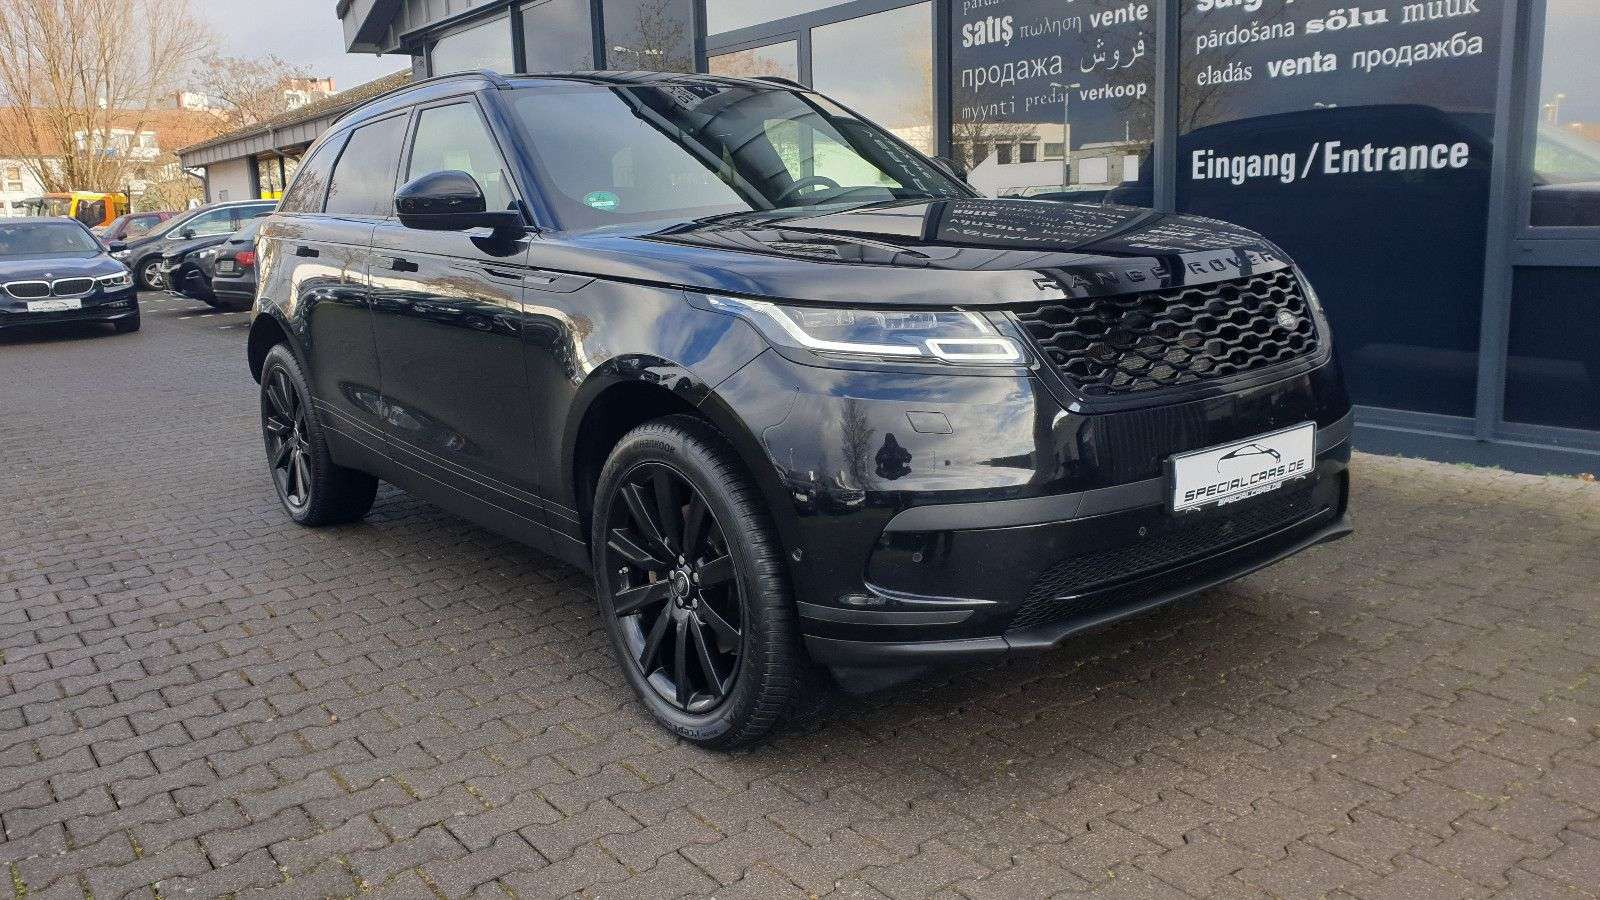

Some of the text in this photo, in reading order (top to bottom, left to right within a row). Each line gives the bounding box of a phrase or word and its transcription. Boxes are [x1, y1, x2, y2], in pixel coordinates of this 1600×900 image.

[1019, 15, 1082, 40] πώληση
[1089, 3, 1149, 28] vente
[1305, 7, 1388, 35] sölu
[962, 15, 1014, 48] satış
[1196, 20, 1295, 54] pārdošana
[1080, 32, 1145, 73] فروش
[1267, 51, 1337, 78] venta
[1352, 31, 1483, 72] продажба
[961, 55, 1062, 92] продажа
[1197, 61, 1252, 86] eladás
[1079, 83, 1147, 101] verkoop
[961, 96, 1016, 122] myynti
[1192, 150, 1296, 185] Eingang
[1323, 141, 1469, 174] Entrance
[1184, 459, 1305, 502] SPECIALCARS.DE
